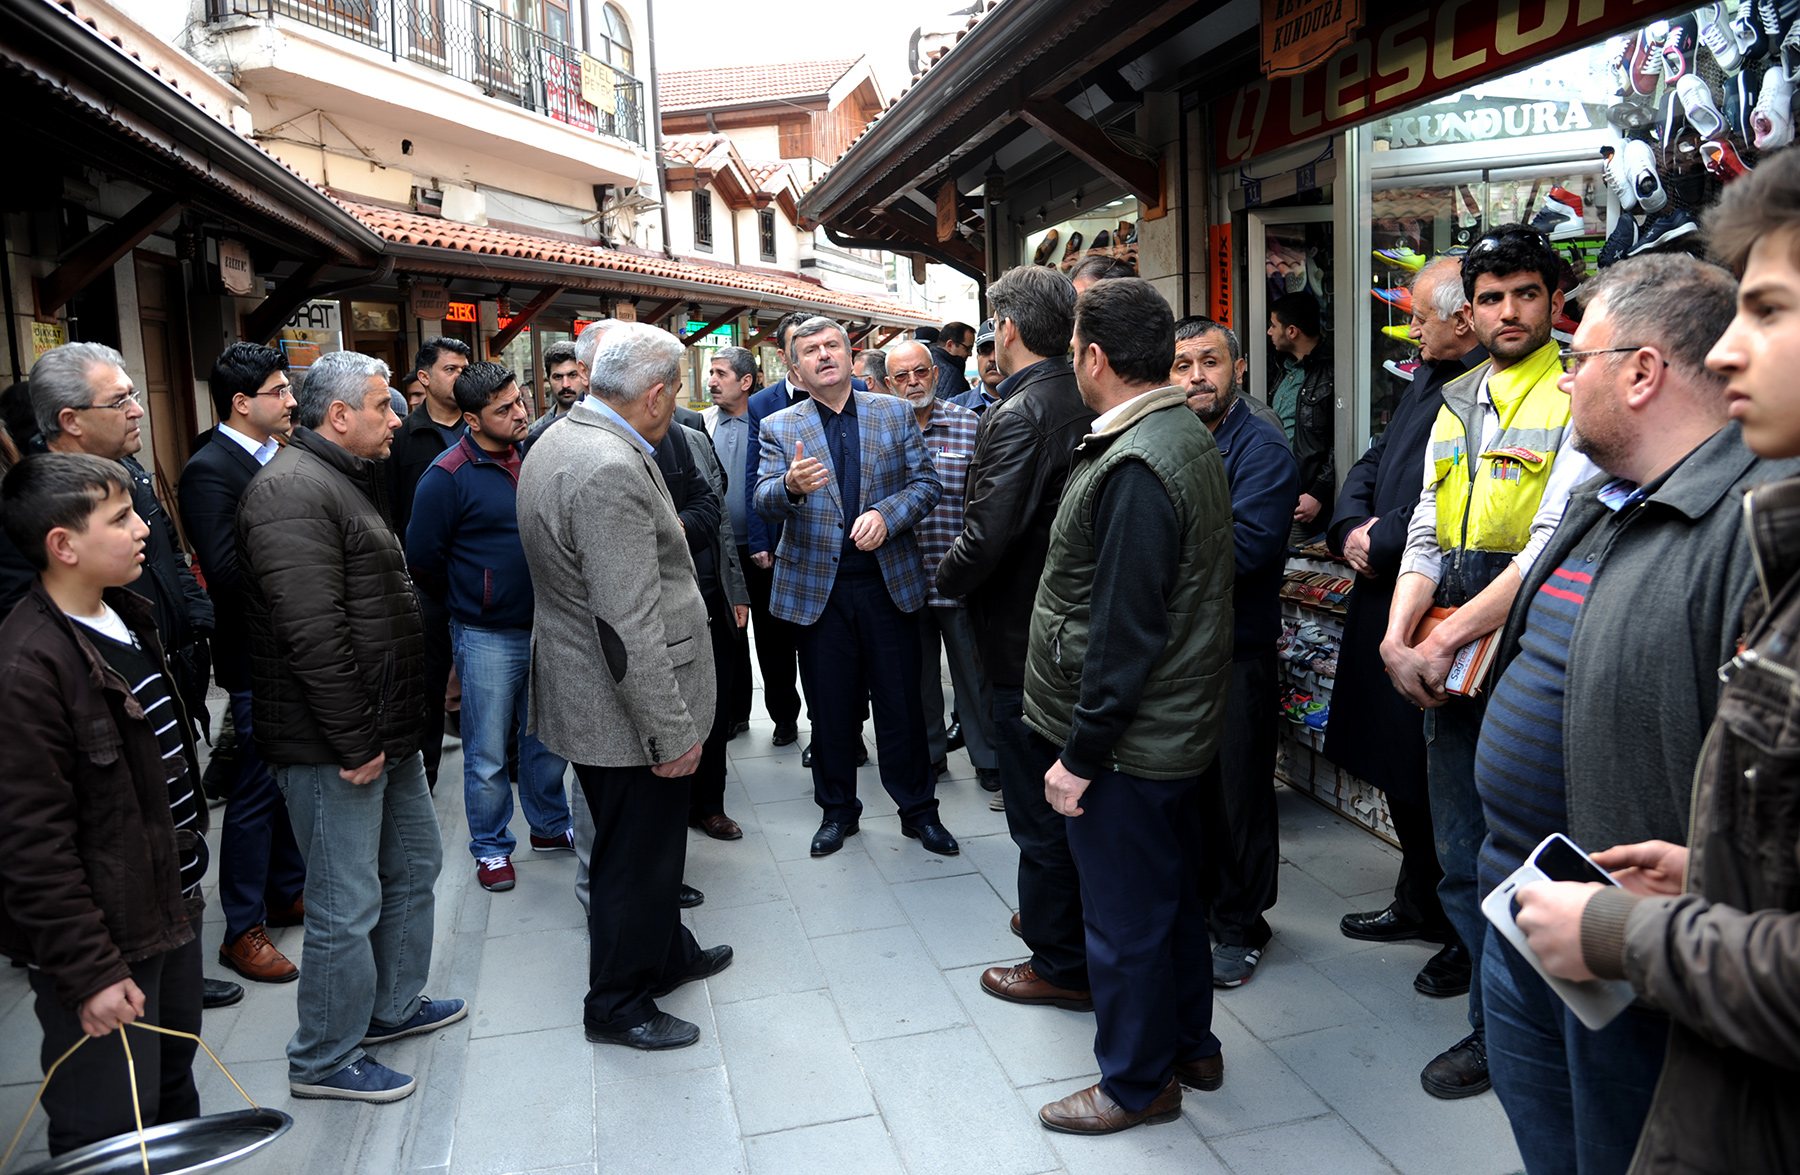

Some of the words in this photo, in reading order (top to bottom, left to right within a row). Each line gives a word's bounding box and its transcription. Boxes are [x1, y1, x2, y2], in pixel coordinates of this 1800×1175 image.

[1273, 1, 1342, 53] KUNDURA
[583, 57, 612, 85] OTEL
[1390, 99, 1592, 149] KUNDURA
[1248, 185, 1258, 200] 11
[1300, 169, 1311, 185] 13
[1218, 236, 1229, 323] kinetix
